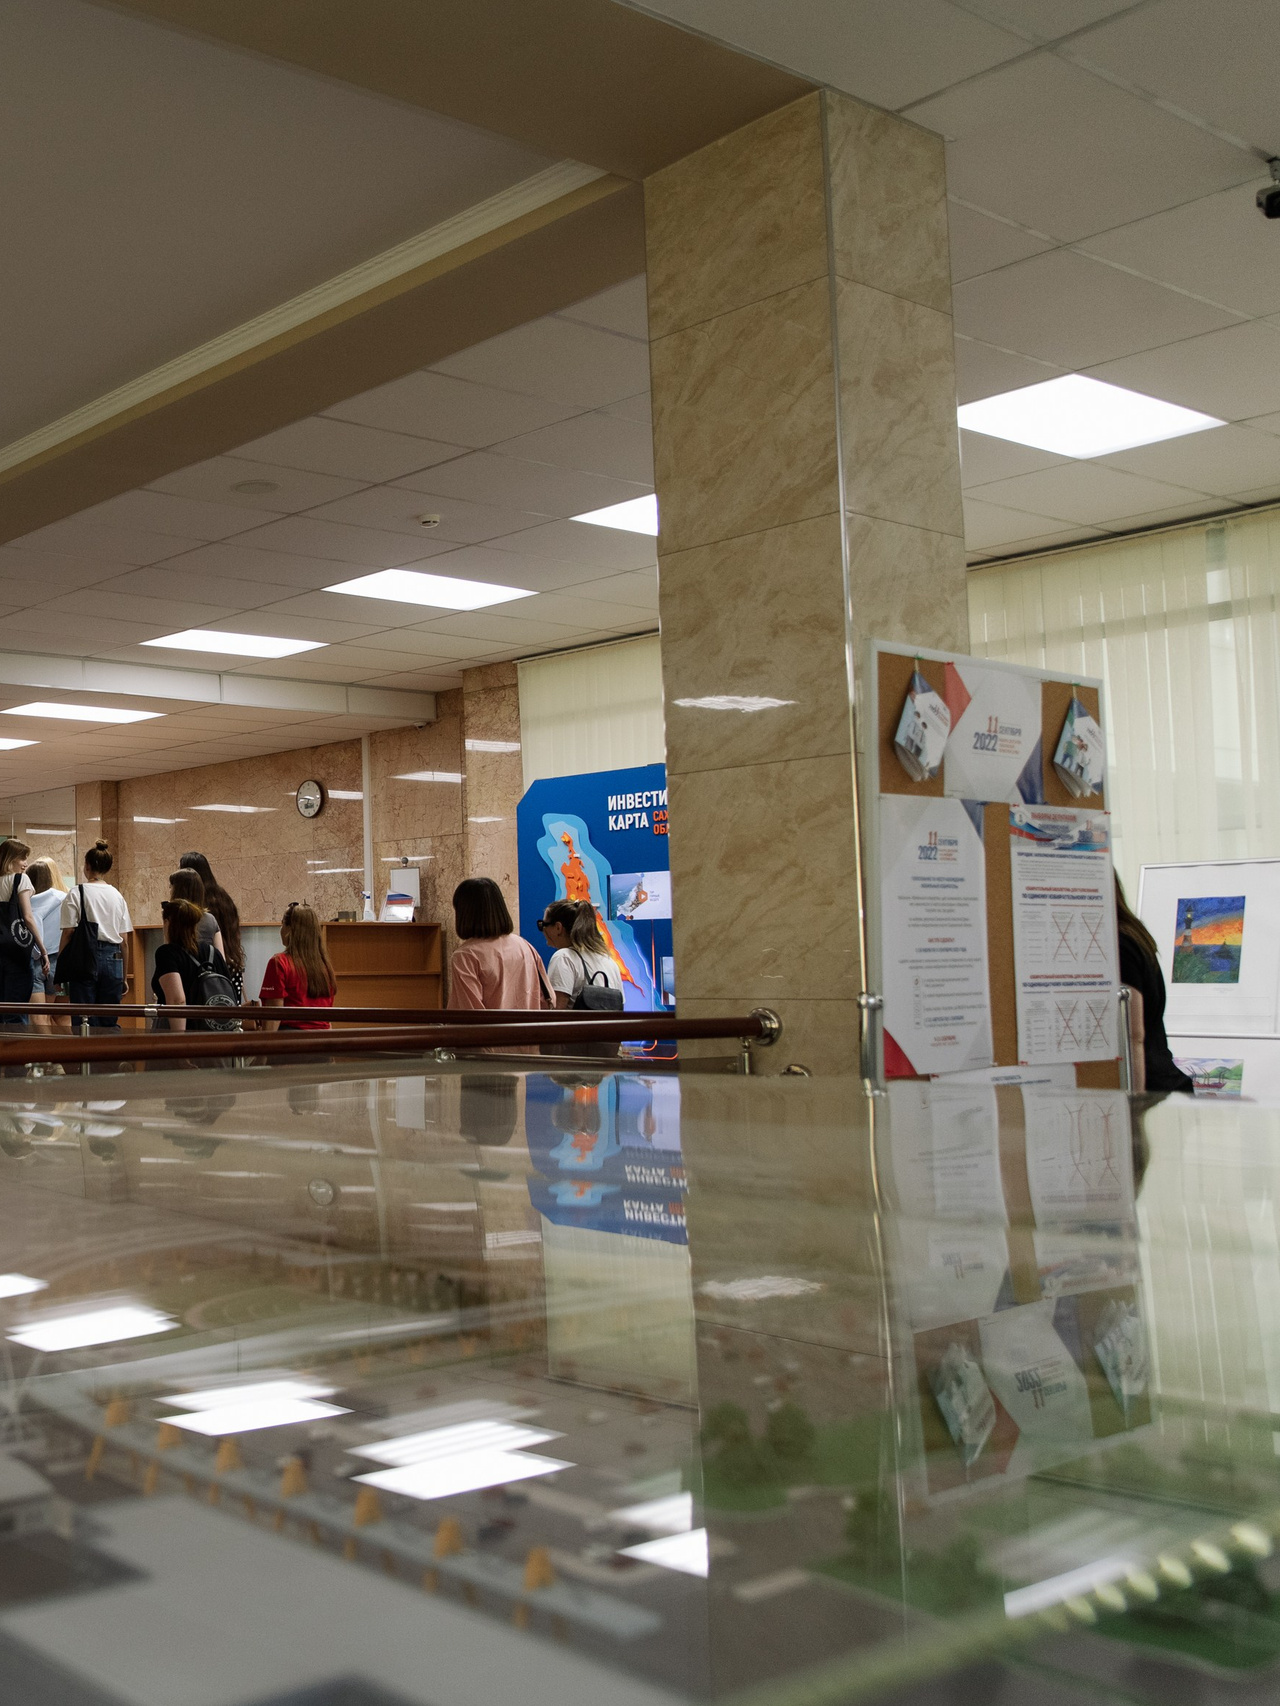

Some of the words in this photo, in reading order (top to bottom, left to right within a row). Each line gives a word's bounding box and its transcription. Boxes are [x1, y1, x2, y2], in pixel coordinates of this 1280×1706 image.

[987, 715, 998, 734] 11
[973, 732, 998, 752] 2022
[607, 790, 668, 811] ИНВЕСТИ
[608, 812, 649, 831] КАРТА
